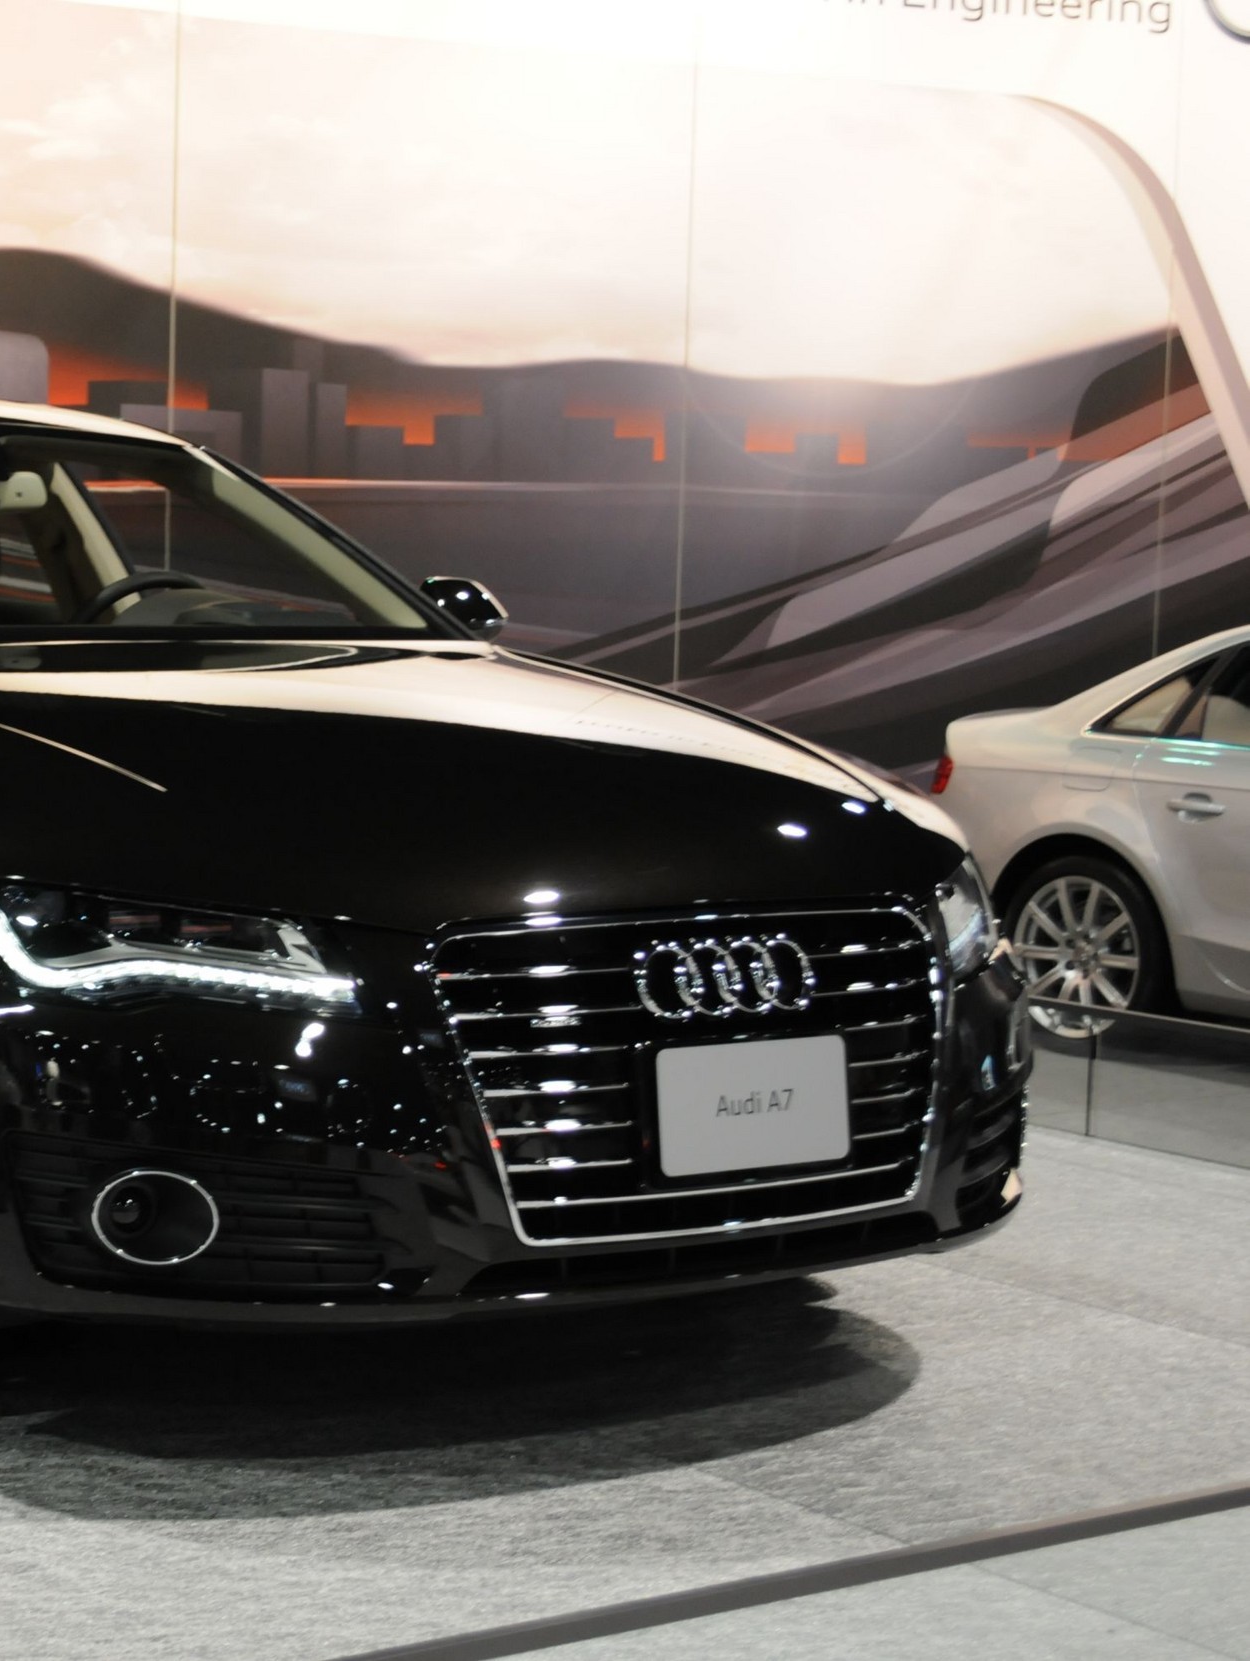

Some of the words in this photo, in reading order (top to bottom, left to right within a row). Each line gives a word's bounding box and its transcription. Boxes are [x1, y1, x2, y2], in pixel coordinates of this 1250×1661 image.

[903, 0, 1171, 34] gneering
[716, 1091, 762, 1117] Audi
[766, 1088, 795, 1113] A7
